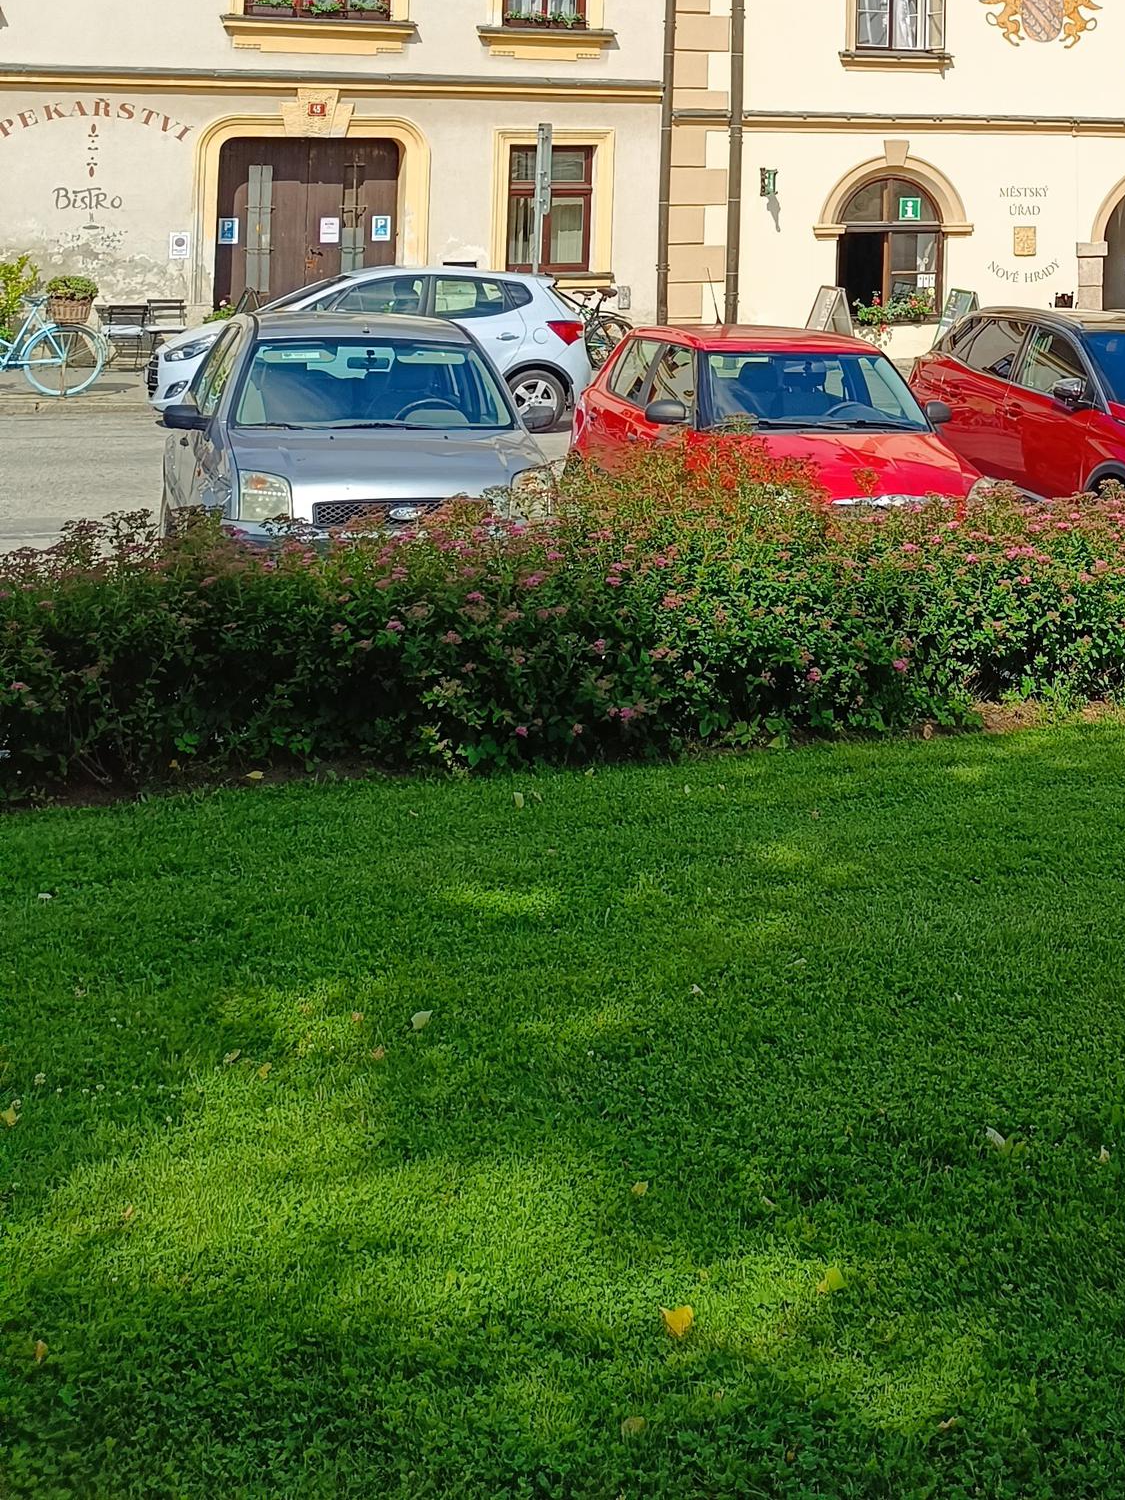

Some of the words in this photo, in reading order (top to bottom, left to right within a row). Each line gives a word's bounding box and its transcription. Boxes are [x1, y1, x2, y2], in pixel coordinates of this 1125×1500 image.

[0, 98, 194, 142] PEKAŘSTVÍ
[999, 185, 1049, 198] MĚSTSKÝ
[1009, 203, 1041, 216] ÚŘAD
[987, 260, 1020, 283] NOVÉ
[1024, 258, 1060, 283] HRADY
